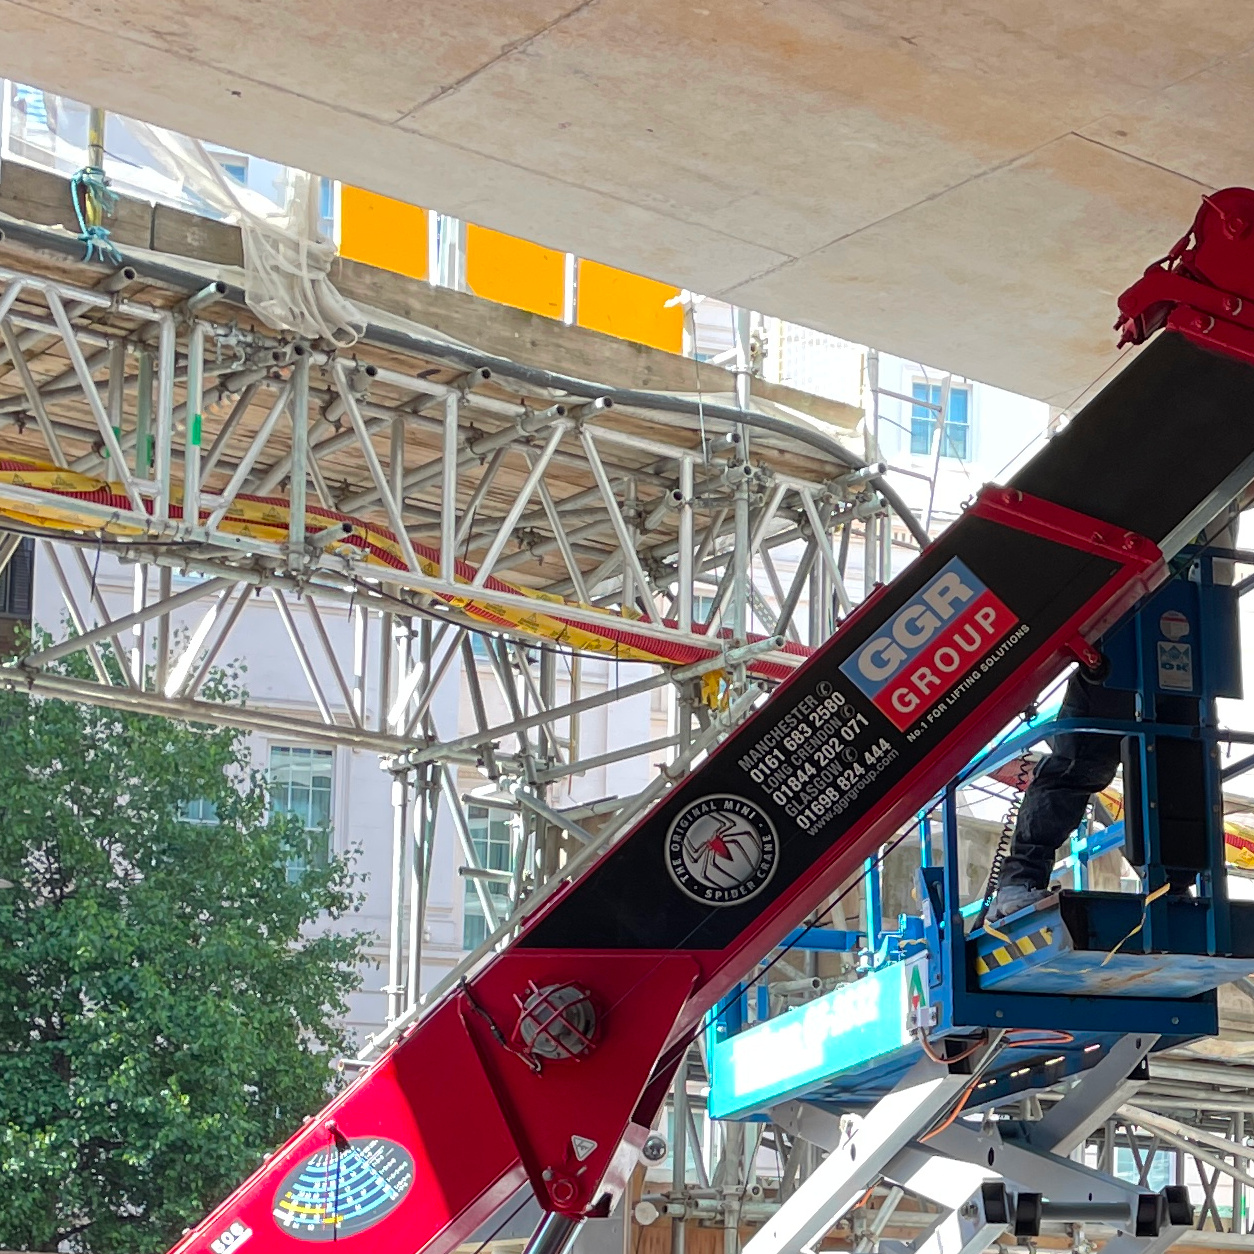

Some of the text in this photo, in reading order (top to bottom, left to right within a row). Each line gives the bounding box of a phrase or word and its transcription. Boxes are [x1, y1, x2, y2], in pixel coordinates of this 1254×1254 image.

[858, 572, 974, 681] GGR
[891, 606, 996, 713] GROUP
[906, 624, 1030, 743] No.1 FOR LIFTING SOLUTIONS
[738, 695, 819, 772] MANCHESTER
[750, 691, 845, 783] 0161 683 2580
[761, 716, 843, 795] LONG CRENDON
[772, 713, 869, 806] 01844 202 071
[785, 760, 843, 817] GLASGOW
[796, 738, 892, 829] 01698 824 444
[807, 749, 899, 836] www.ggrgroup.com
[671, 800, 756, 883] THE ORIGINAL MINI
[704, 834, 773, 900] SPIDER CRANE
